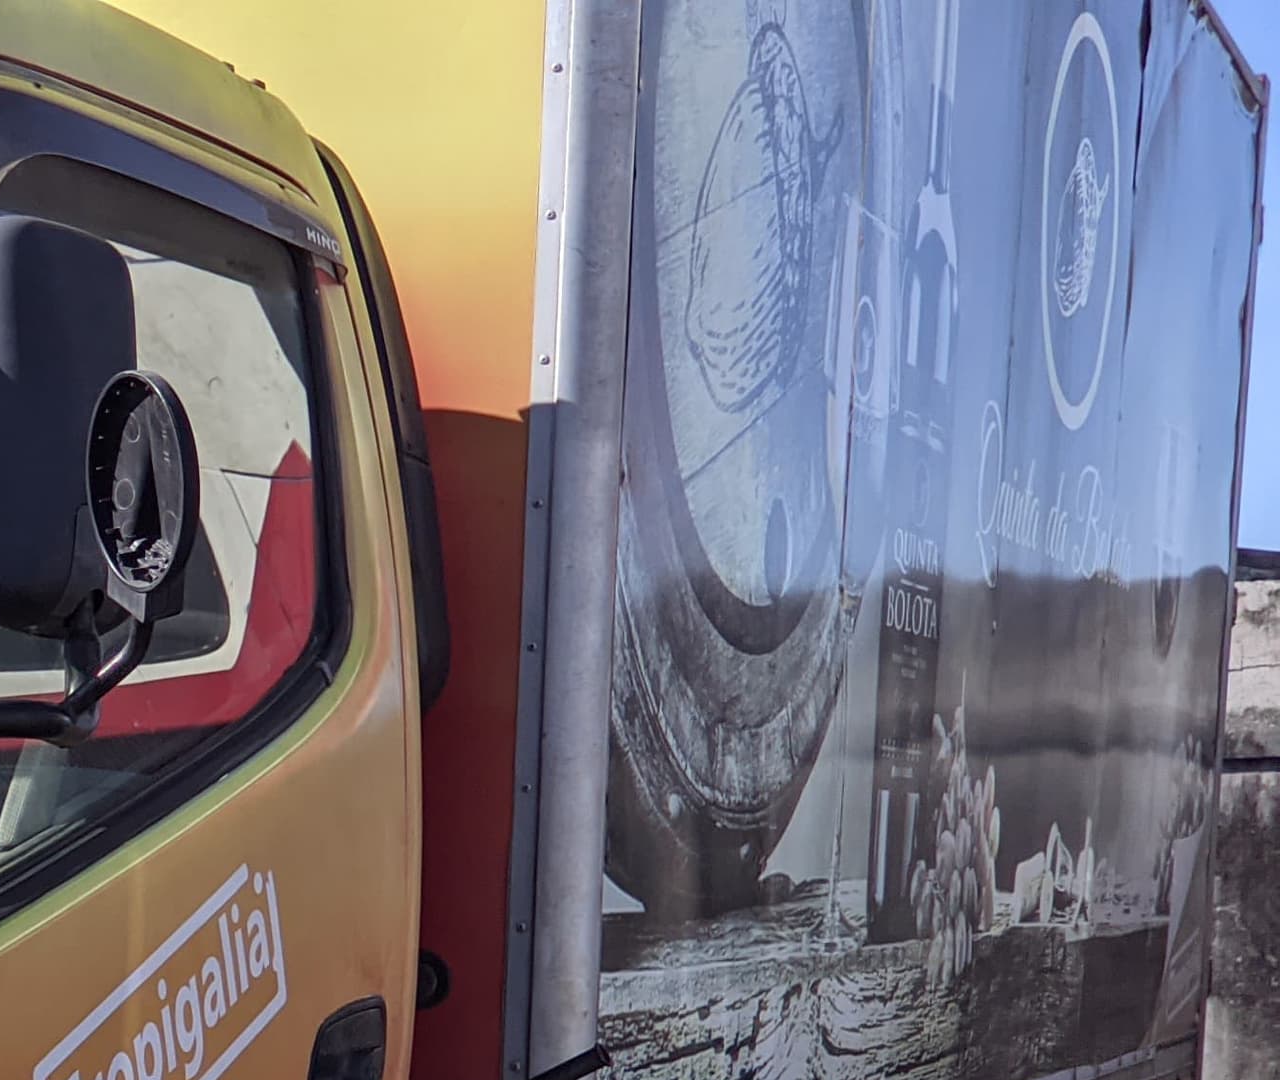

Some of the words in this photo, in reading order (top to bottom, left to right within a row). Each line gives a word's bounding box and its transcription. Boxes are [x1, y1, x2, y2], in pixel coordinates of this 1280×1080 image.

[306, 227, 340, 257] HINO
[893, 527, 939, 577] QUINTA
[886, 585, 939, 640] BOLOTA
